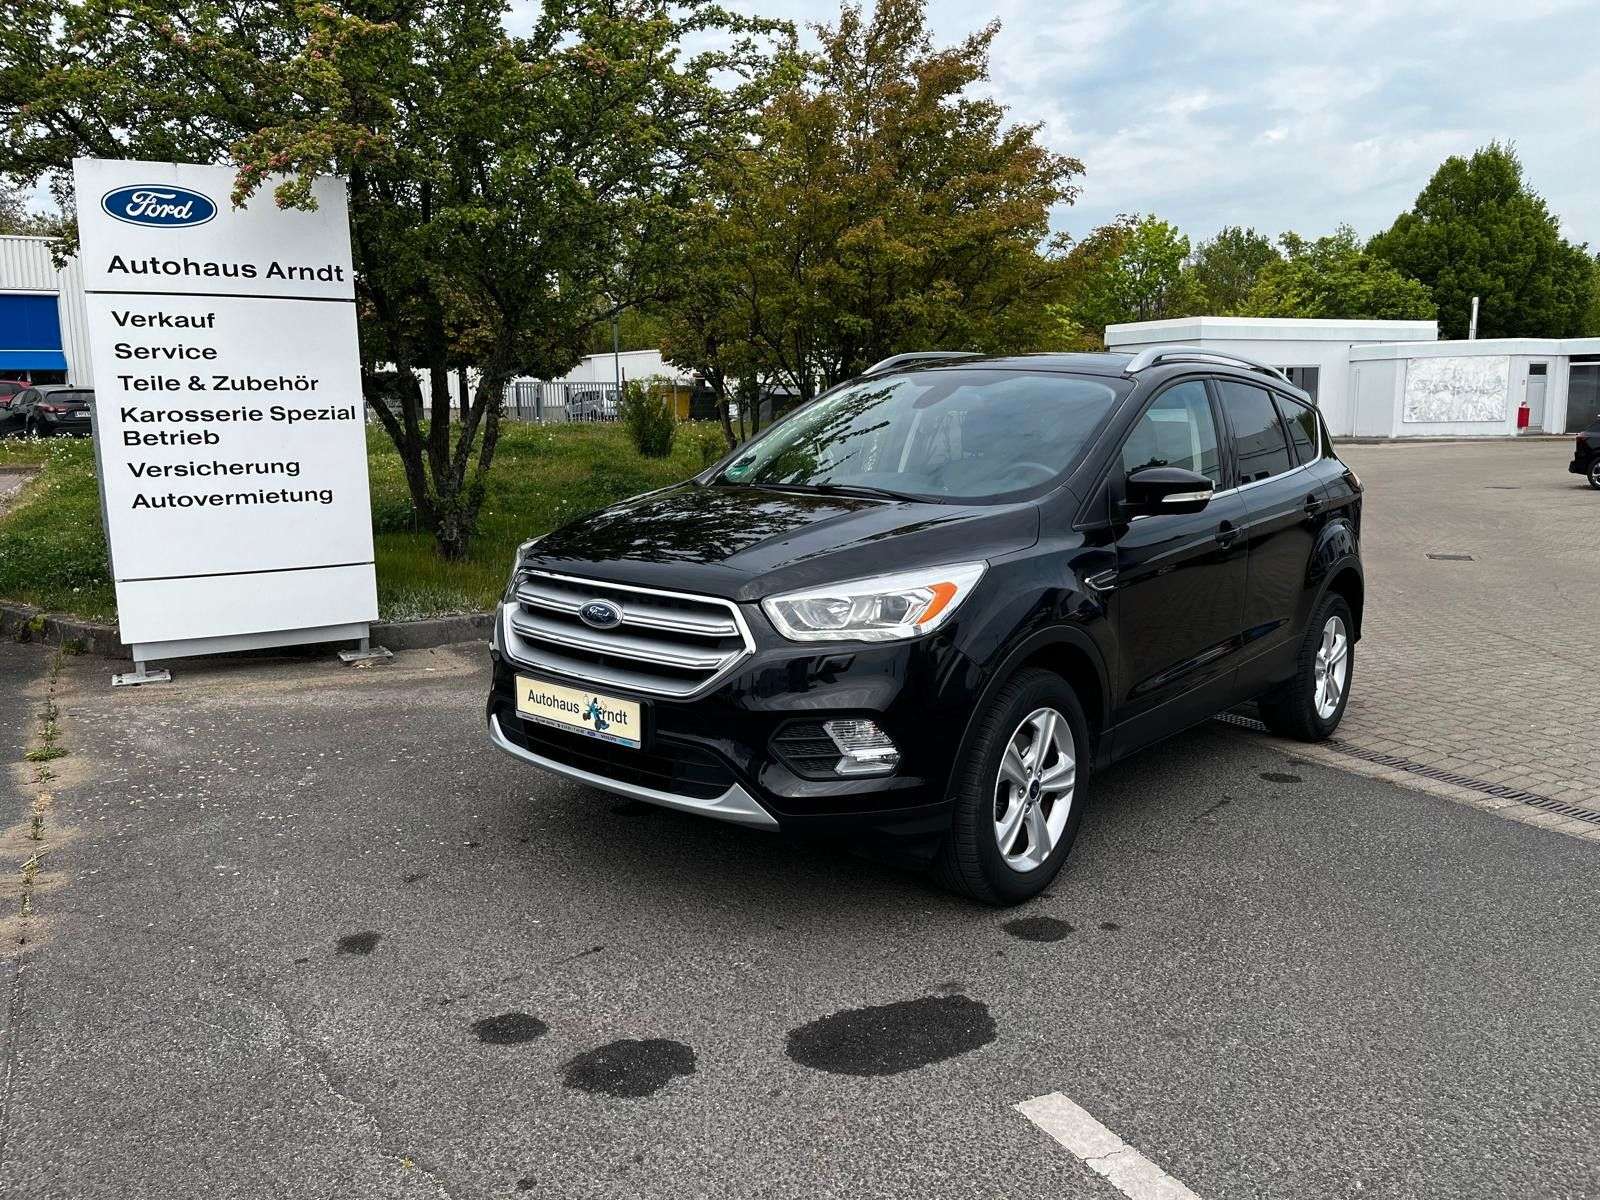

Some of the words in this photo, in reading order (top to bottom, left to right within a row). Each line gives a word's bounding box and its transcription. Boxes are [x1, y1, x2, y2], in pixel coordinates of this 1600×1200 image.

[125, 190, 194, 219] Ford
[107, 255, 258, 279] Autohaus
[265, 261, 345, 282] Arndt
[111, 310, 216, 329] Verkauf
[114, 342, 218, 360] Service
[117, 375, 181, 392] Teile
[187, 375, 207, 392] &
[211, 375, 319, 392] Zubehör
[120, 406, 264, 423] Karosserie
[269, 405, 356, 425] Spezial
[123, 429, 220, 446] Betrieb
[126, 460, 300, 478] Versicherung
[131, 488, 333, 509] Autovermietung
[527, 689, 580, 714] Autohaus
